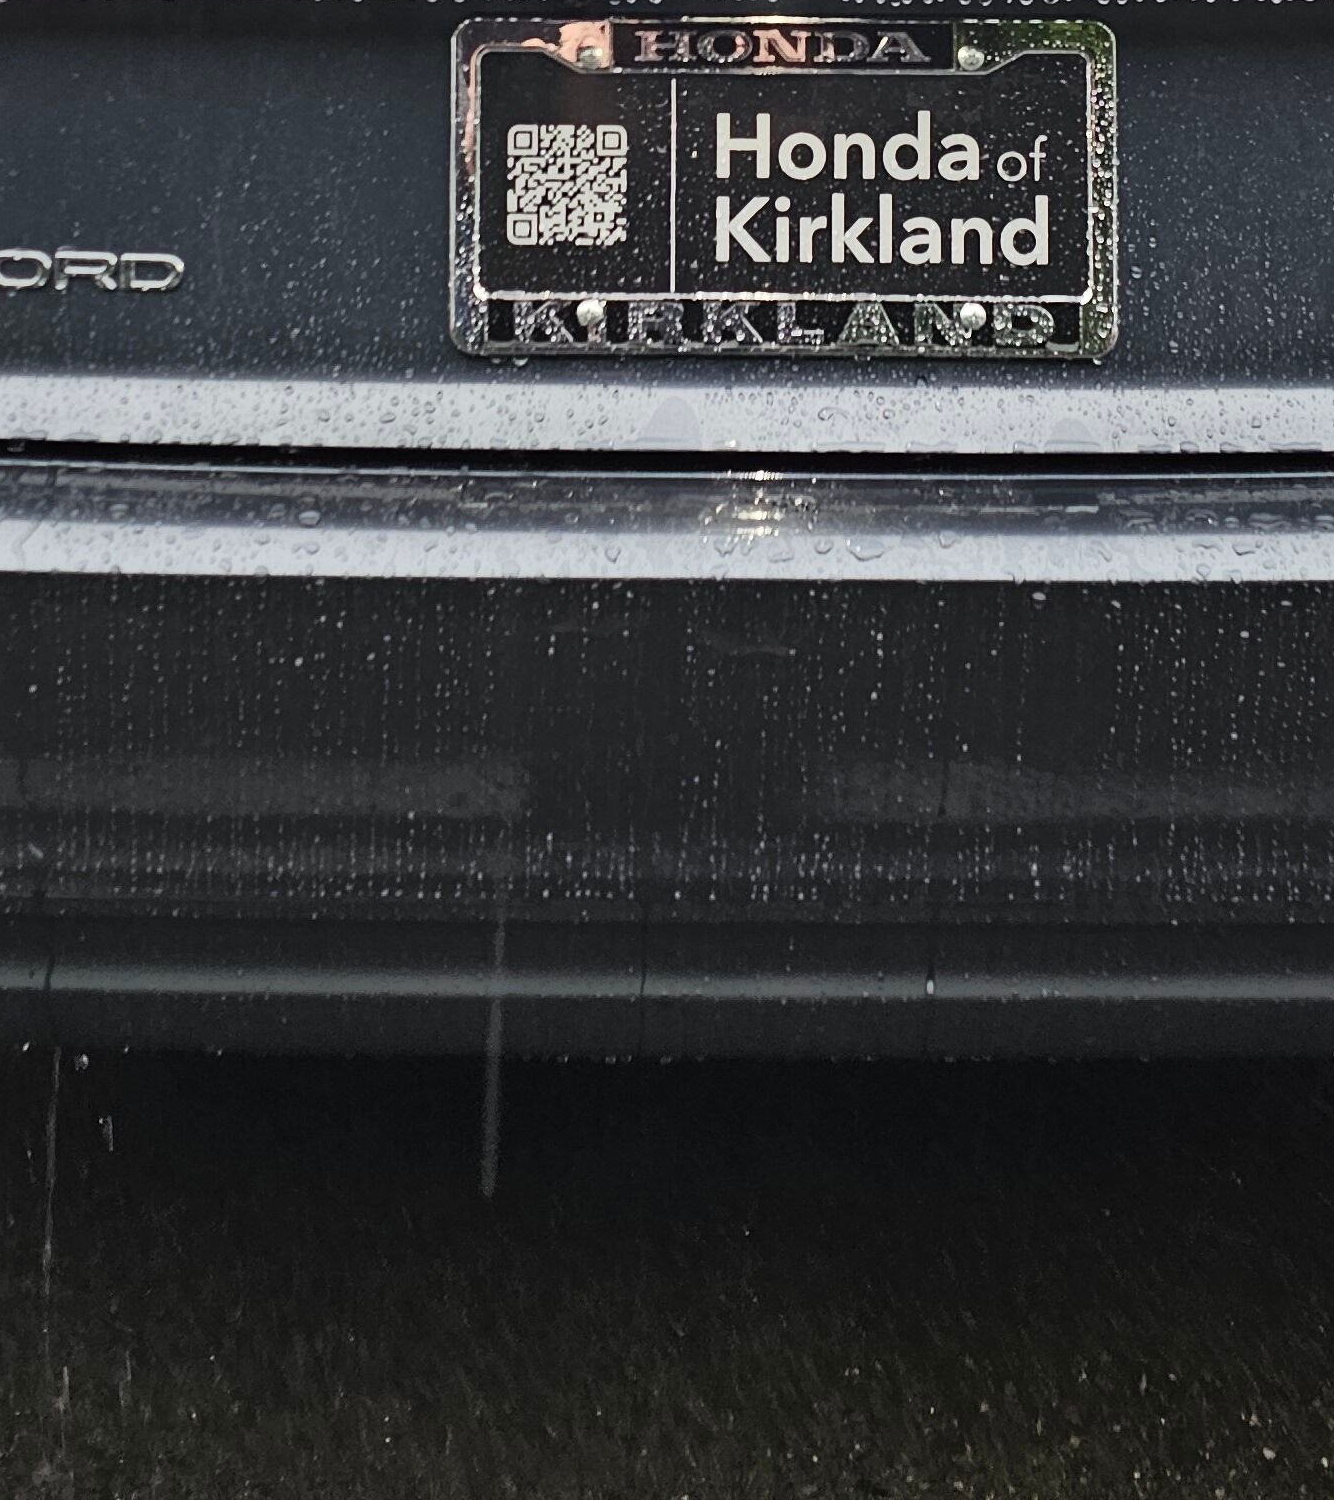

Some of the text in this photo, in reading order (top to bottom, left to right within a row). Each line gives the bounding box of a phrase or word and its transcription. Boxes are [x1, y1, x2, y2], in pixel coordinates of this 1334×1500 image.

[634, 29, 931, 64] HONDA
[716, 110, 1048, 183] Honda of
[716, 192, 1049, 266] Kirkland
